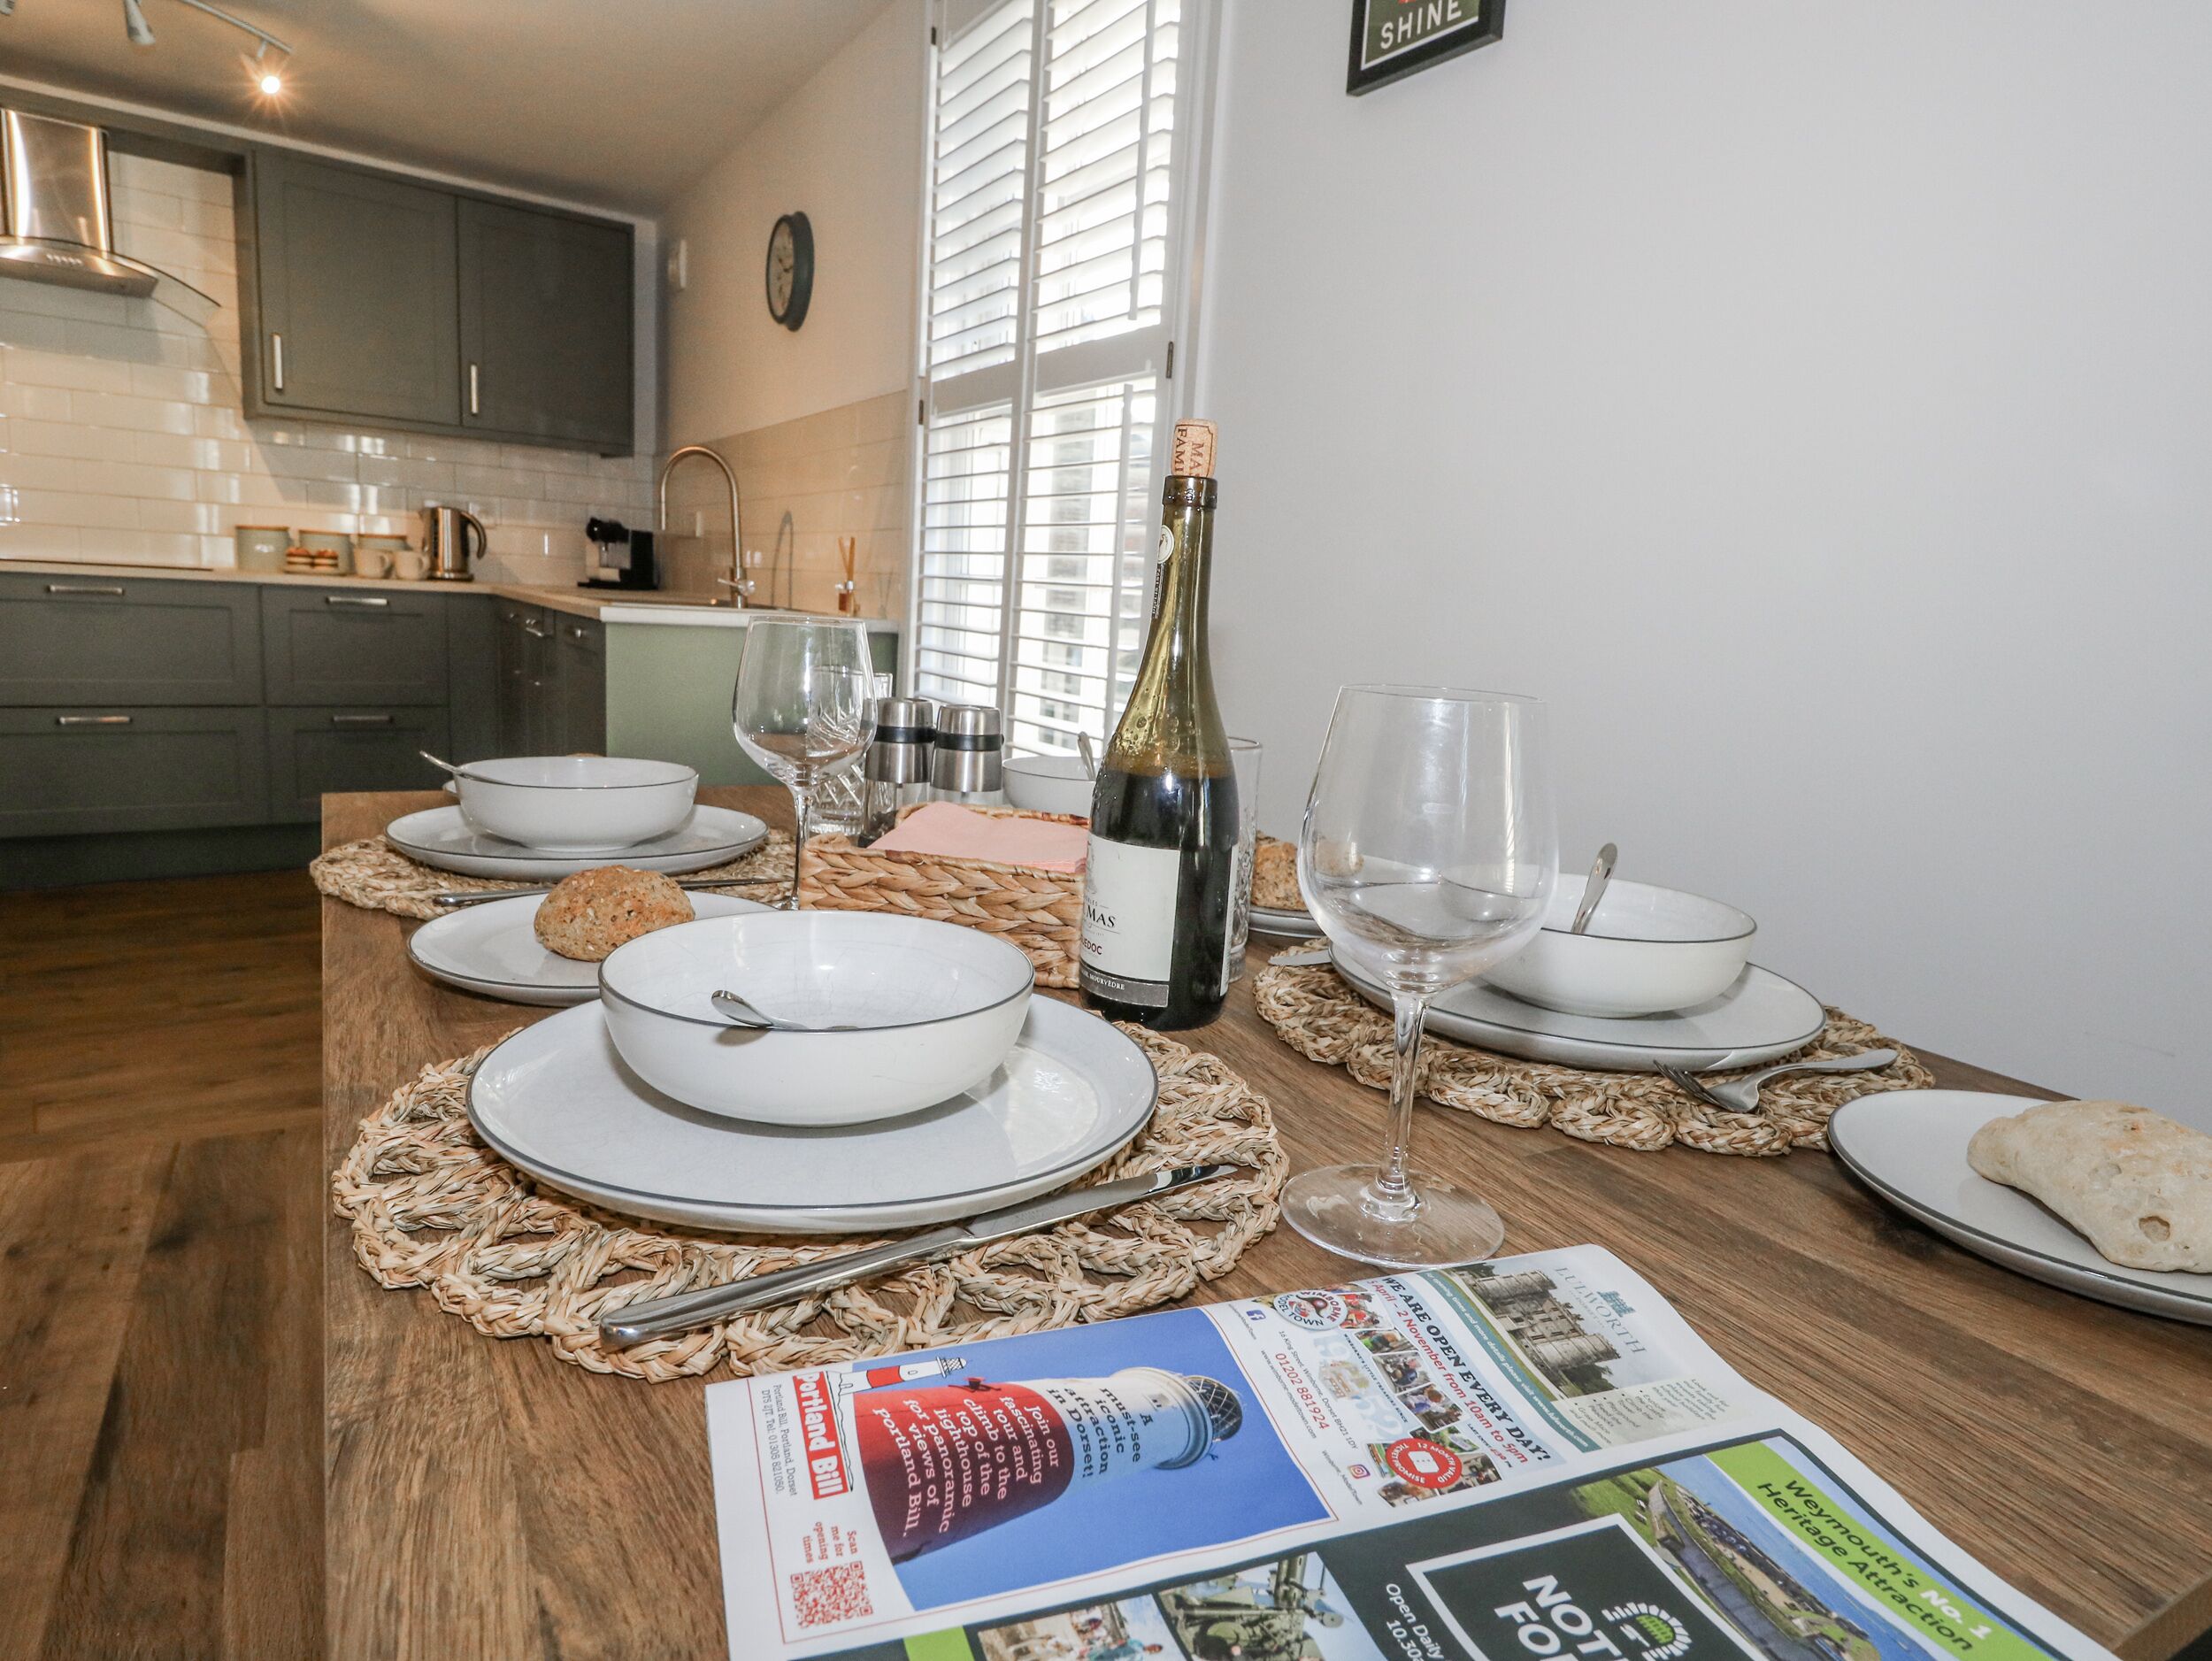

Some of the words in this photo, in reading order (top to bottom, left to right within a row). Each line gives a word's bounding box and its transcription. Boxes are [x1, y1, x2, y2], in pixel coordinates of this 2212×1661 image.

[1380, 0, 1462, 50] SHINE
[1087, 904, 1116, 928] MAS
[1288, 1311, 1324, 1326] TOWN
[1301, 1291, 1341, 1322] WIMBORNE
[1555, 1267, 1647, 1352] LULWORTH
[1275, 1352, 1303, 1386] 01202
[1296, 1386, 1330, 1430] 881924
[1372, 1283, 1393, 1303] April
[1403, 1318, 1447, 1372] November
[1443, 1373, 1467, 1399] from
[1465, 1400, 1493, 1429] 10am
[1491, 1429, 1504, 1442] to
[1502, 1443, 1528, 1463] 5pm
[1382, 1276, 1405, 1293] WE
[1401, 1291, 1431, 1323] ARE
[1426, 1325, 1466, 1368] OPEN
[1460, 1371, 1514, 1423] EVERY
[1505, 1426, 1551, 1461] DAY!
[796, 1372, 836, 1452] Portland
[956, 1410, 978, 1438] top
[964, 1398, 999, 1442] climb
[1047, 1388, 1066, 1404] in
[1066, 1408, 1094, 1478] Dorset!
[1064, 1388, 1110, 1474] attraction
[1094, 1398, 1126, 1453] iconic
[1099, 1388, 1141, 1463] must-see
[1140, 1413, 1154, 1427] A
[933, 1408, 973, 1508] lighthouse
[974, 1441, 990, 1460] of
[993, 1408, 1018, 1441] tour
[1012, 1445, 1028, 1481] and
[994, 1444, 1006, 1463] to
[999, 1396, 1042, 1485] fascinating
[1025, 1405, 1052, 1435] Join
[1046, 1438, 1059, 1468] our
[1392, 1443, 1409, 1462] TICKET
[1430, 1445, 1455, 1465] MONTH
[787, 1466, 797, 1496] Dorset
[811, 1456, 843, 1496] Bill
[903, 1399, 930, 1421] for
[923, 1421, 955, 1534] panoramic
[908, 1423, 936, 1479] views
[926, 1483, 940, 1508] of
[979, 1465, 993, 1496] the
[997, 1467, 1010, 1500] the
[1392, 1459, 1426, 1484] PROMISE
[1437, 1465, 1456, 1483] VALID
[831, 1526, 840, 1541] me
[902, 1492, 922, 1538] Bill.
[813, 1521, 828, 1560] opening
[847, 1530, 857, 1555] Scan
[1785, 1480, 1919, 1588] Weymouth's
[1920, 1588, 1964, 1625] No.
[1969, 1626, 1993, 1639] 1
[1757, 1482, 1849, 1557] Heritage
[1847, 1560, 1975, 1651] Attraction
[1386, 1583, 1417, 1624] Open
[1413, 1625, 1444, 1660] Daily
